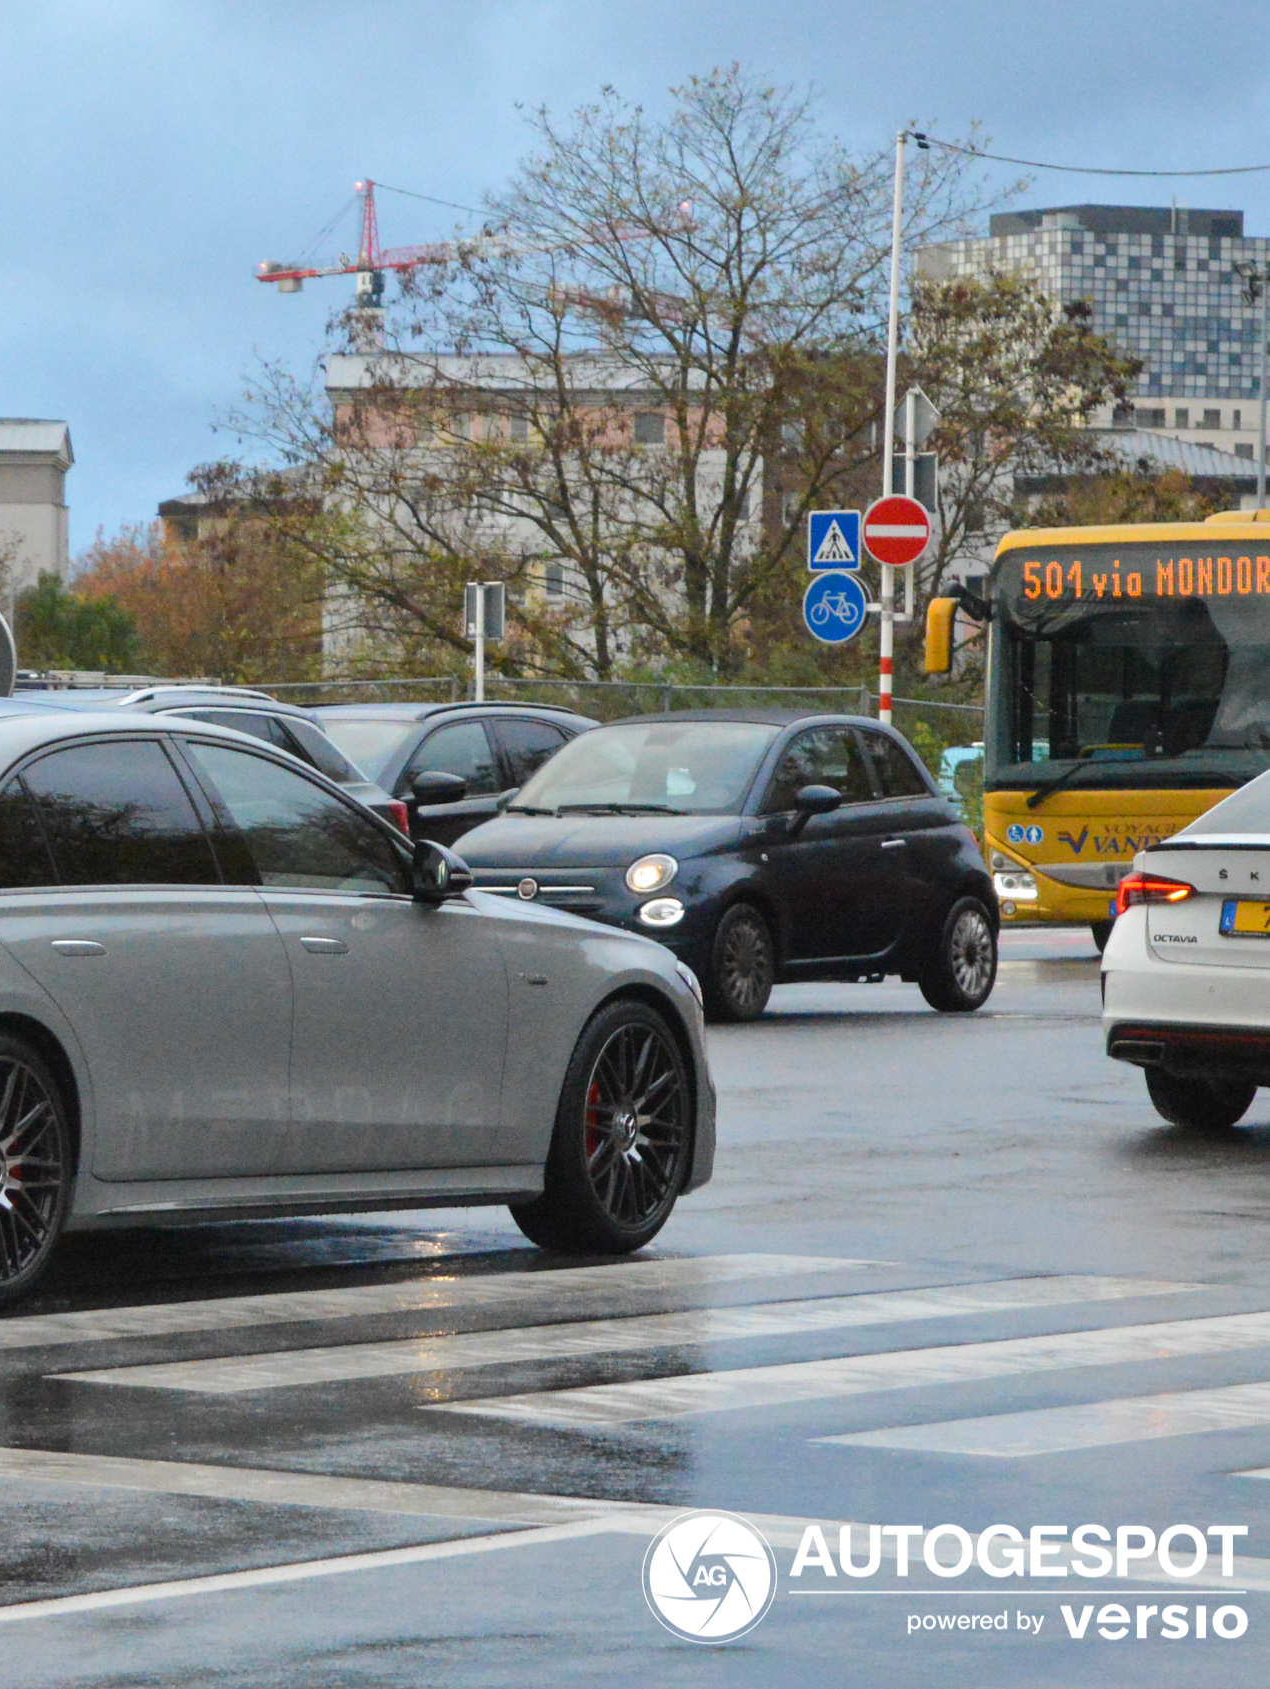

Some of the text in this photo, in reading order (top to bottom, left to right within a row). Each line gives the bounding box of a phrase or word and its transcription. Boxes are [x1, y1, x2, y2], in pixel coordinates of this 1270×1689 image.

[1023, 555, 1270, 599] 501 via MONDOR
[1153, 934, 1198, 943] OCTAVIA
